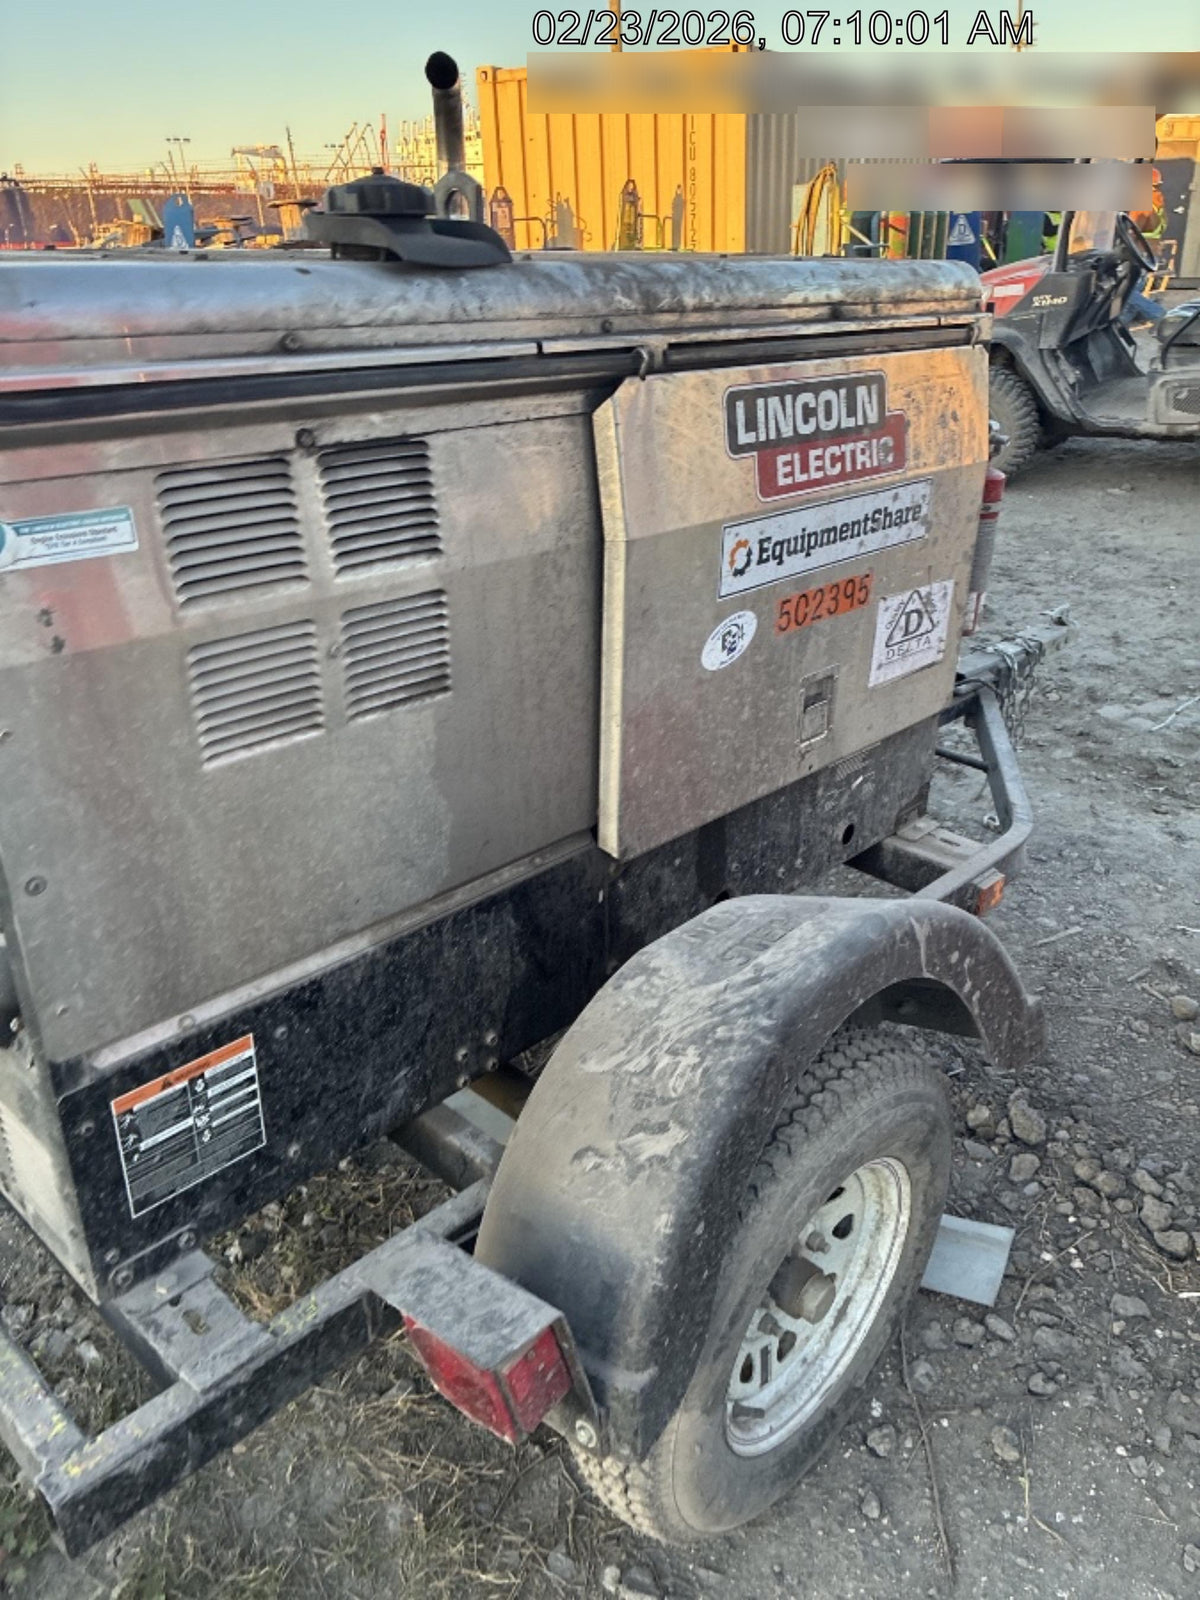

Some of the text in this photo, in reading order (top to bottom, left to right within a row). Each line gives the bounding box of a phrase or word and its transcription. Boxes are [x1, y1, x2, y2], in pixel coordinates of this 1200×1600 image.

[735, 384, 880, 446] LINCOLN
[776, 436, 894, 487] ELECTRIC
[756, 502, 922, 567] EquipmentShare
[885, 635, 932, 660] DELTA
